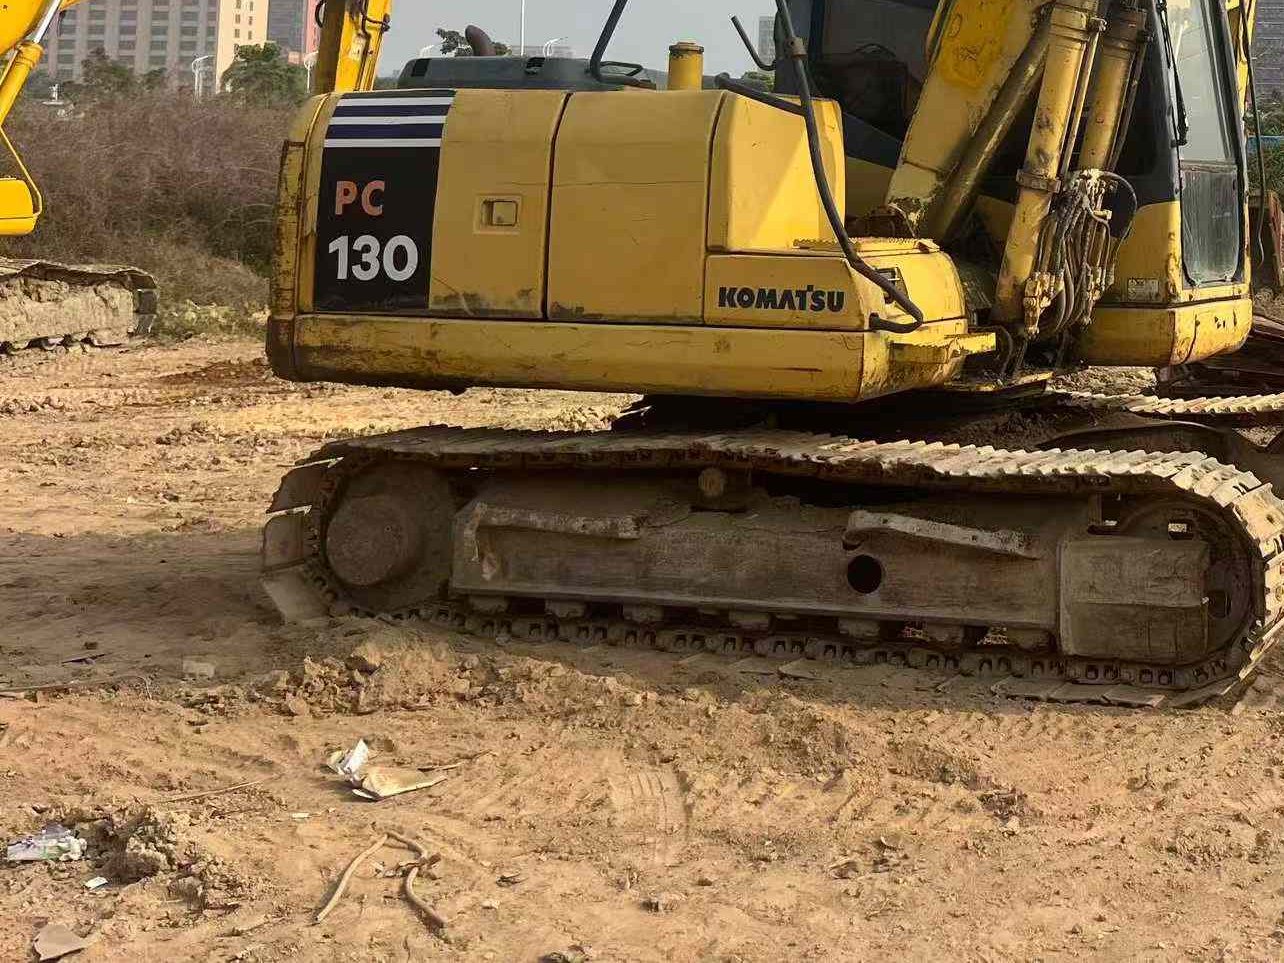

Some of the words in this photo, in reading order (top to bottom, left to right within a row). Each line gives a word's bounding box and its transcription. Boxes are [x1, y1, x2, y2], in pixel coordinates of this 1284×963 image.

[335, 180, 385, 216] PC
[328, 235, 418, 281] 130
[718, 285, 845, 312] KOMATSU
